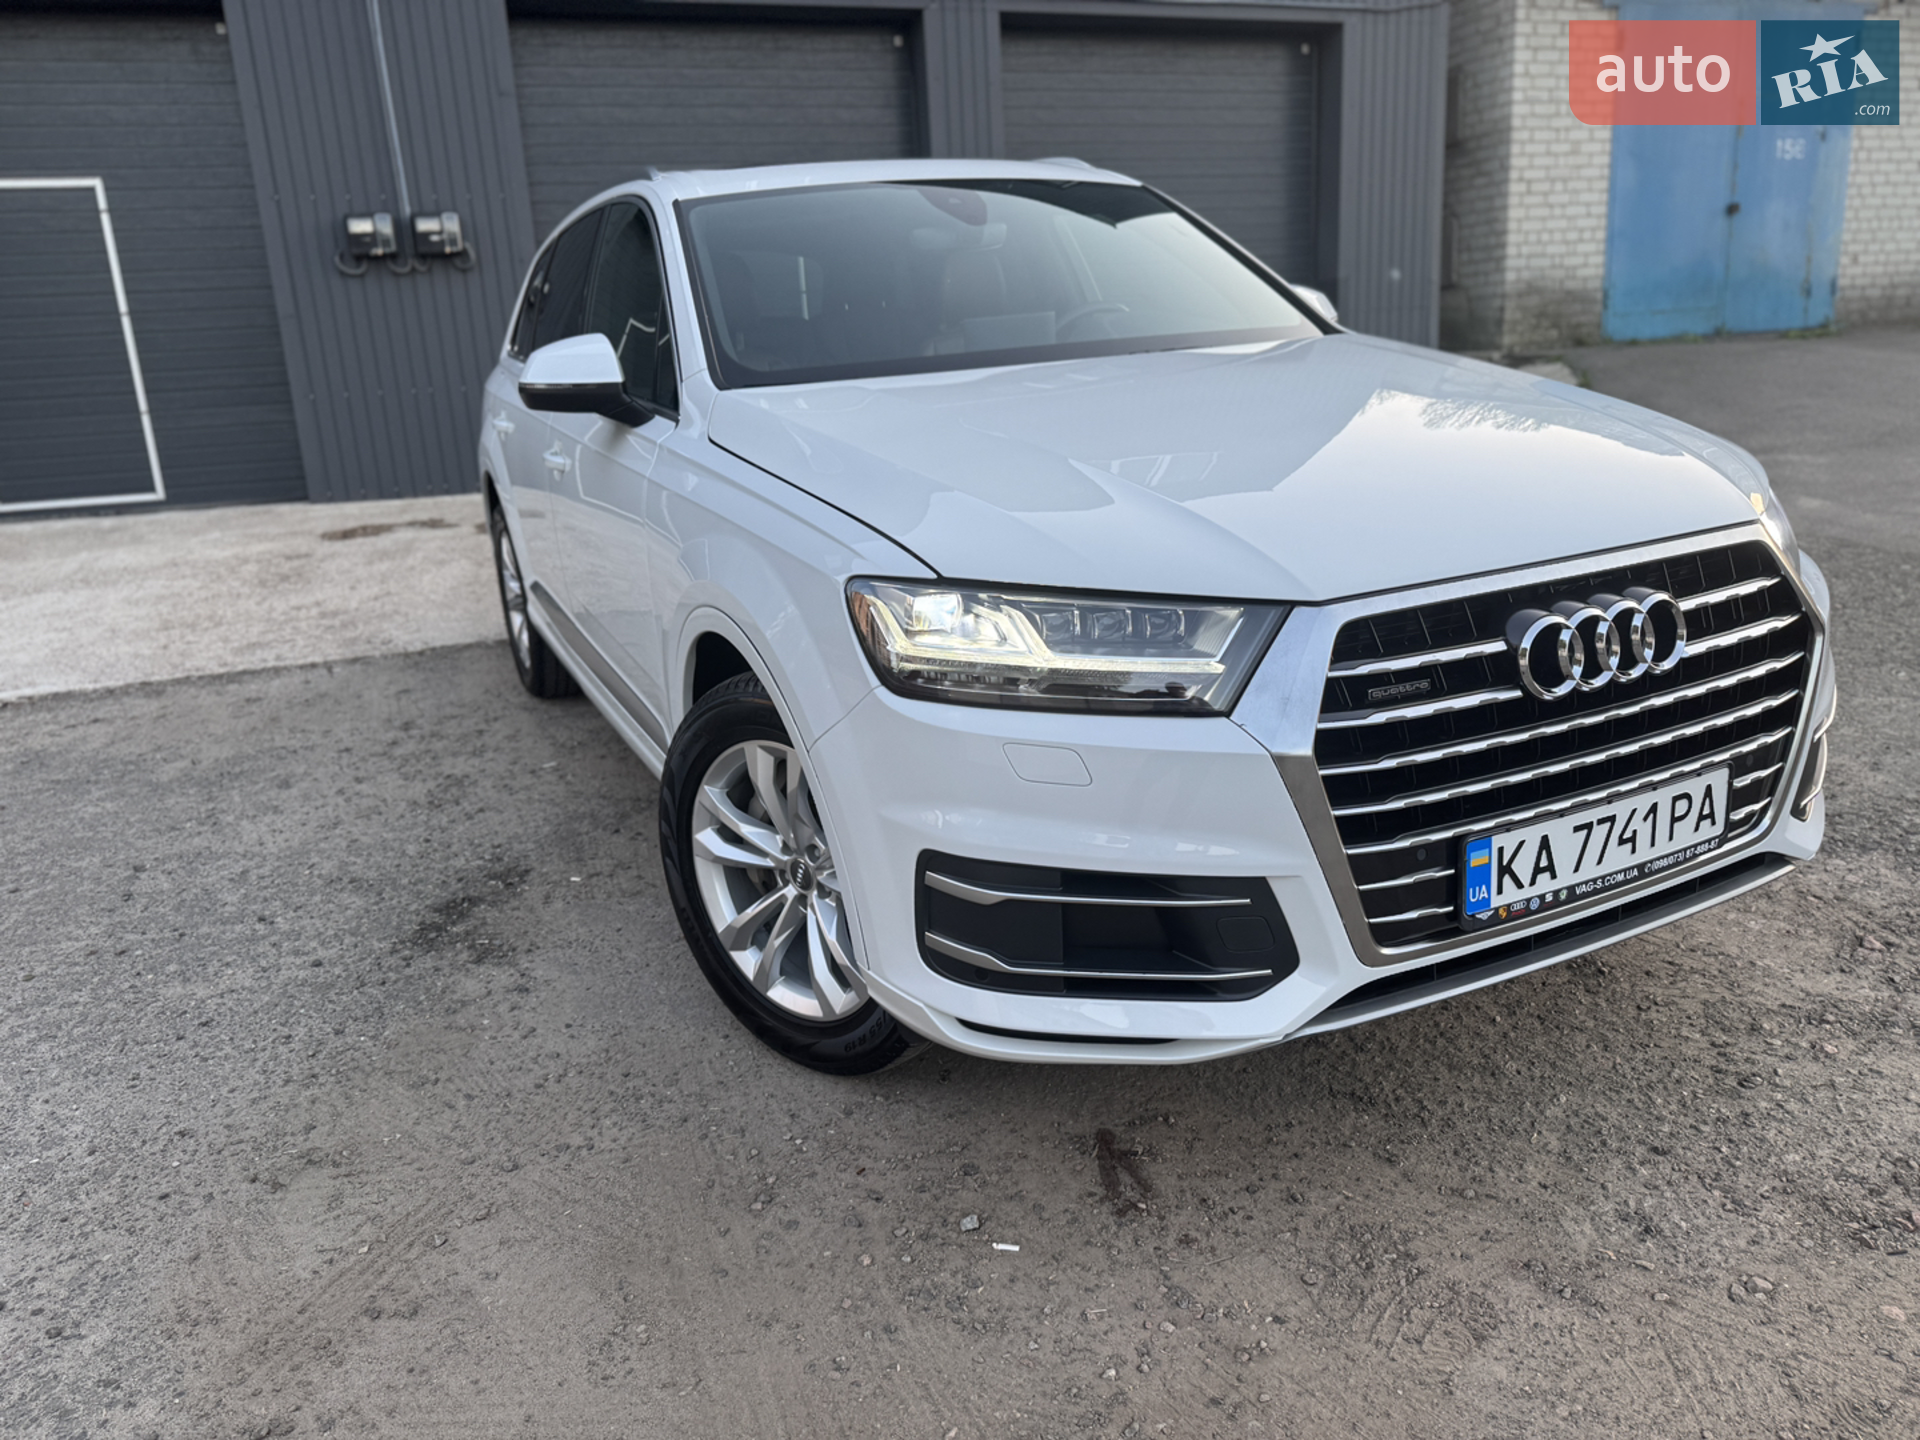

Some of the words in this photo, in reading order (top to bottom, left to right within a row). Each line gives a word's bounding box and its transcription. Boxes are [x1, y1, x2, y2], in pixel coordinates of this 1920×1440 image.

[1371, 681, 1429, 699] quattro
[1496, 834, 1558, 896] KA
[1572, 801, 1659, 874] 7741
[1668, 783, 1717, 843] PA
[1469, 884, 1489, 903] UA
[1575, 867, 1639, 896] VAG-S.COM.UA
